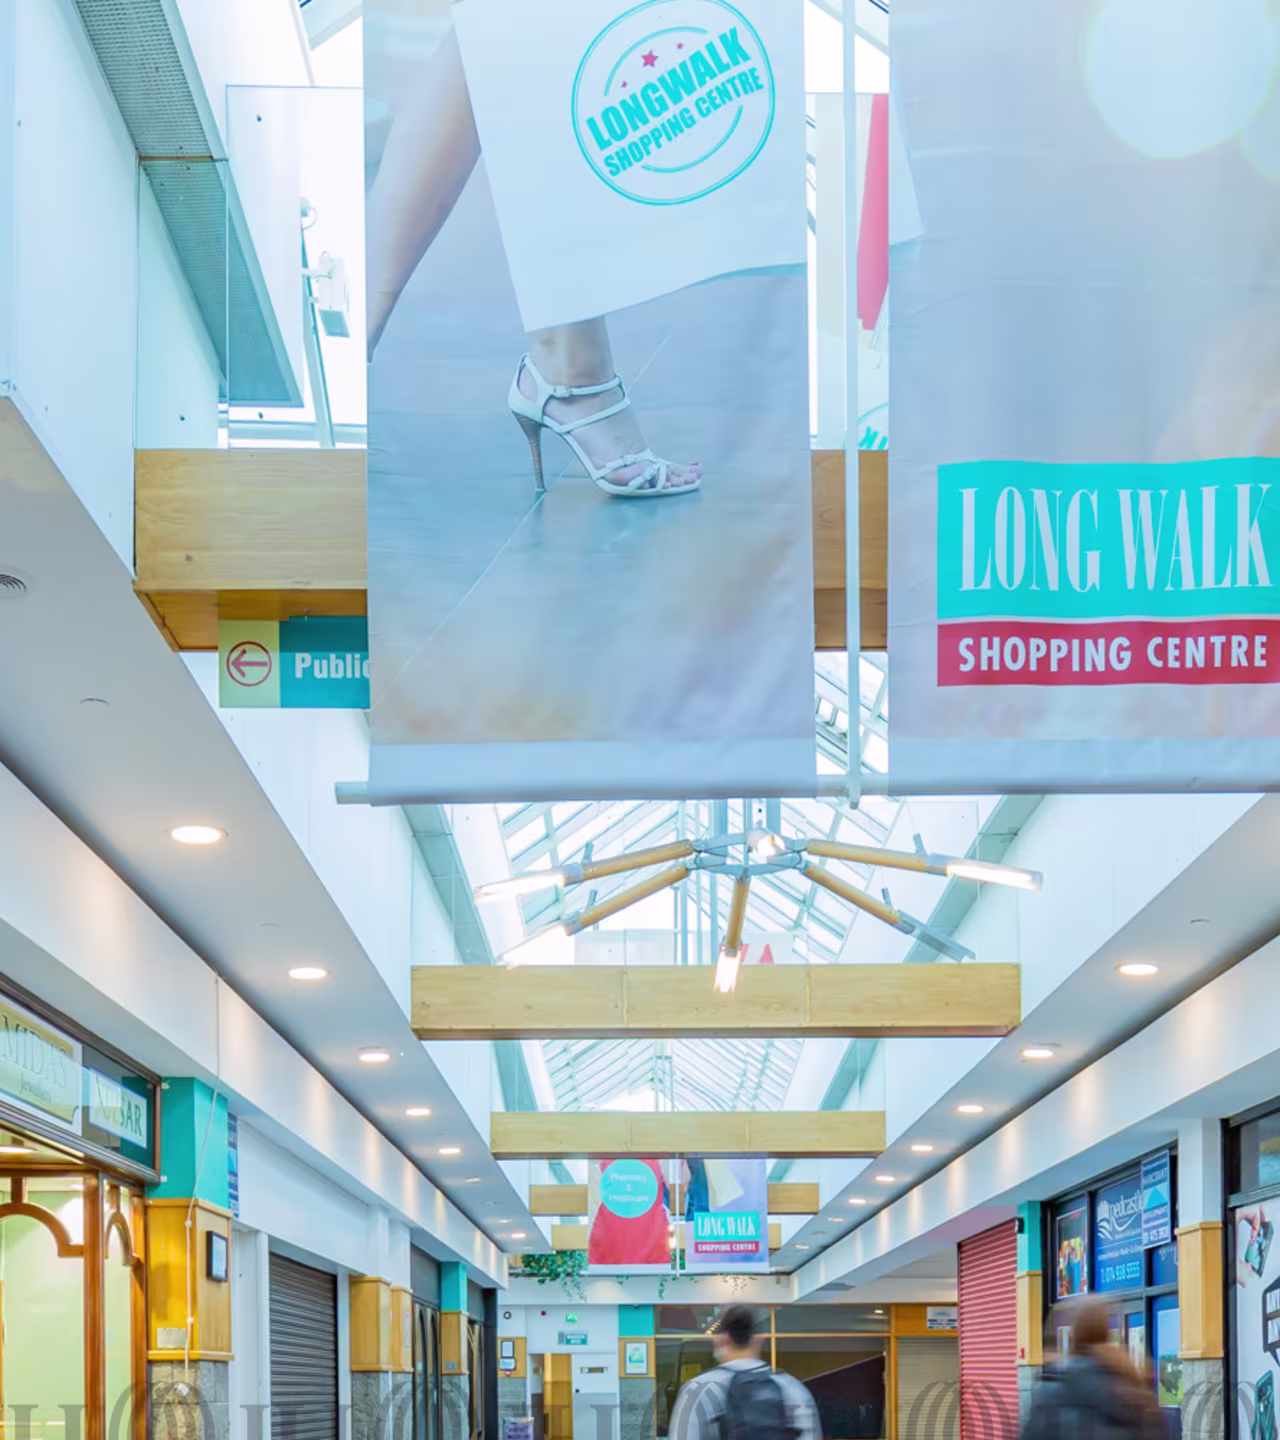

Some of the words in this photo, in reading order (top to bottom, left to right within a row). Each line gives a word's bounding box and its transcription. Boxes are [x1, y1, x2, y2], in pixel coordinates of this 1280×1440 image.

[586, 26, 751, 152] LONGWALK
[604, 107, 697, 177] SHOPPING
[694, 67, 765, 118] CENTRE
[958, 486, 1102, 593] LONG
[1116, 483, 1273, 591] WALK
[958, 636, 1133, 673] SHOPPING
[1146, 635, 1268, 668] CENTRE
[697, 1216, 725, 1237] LONG
[726, 1215, 756, 1237] WALK
